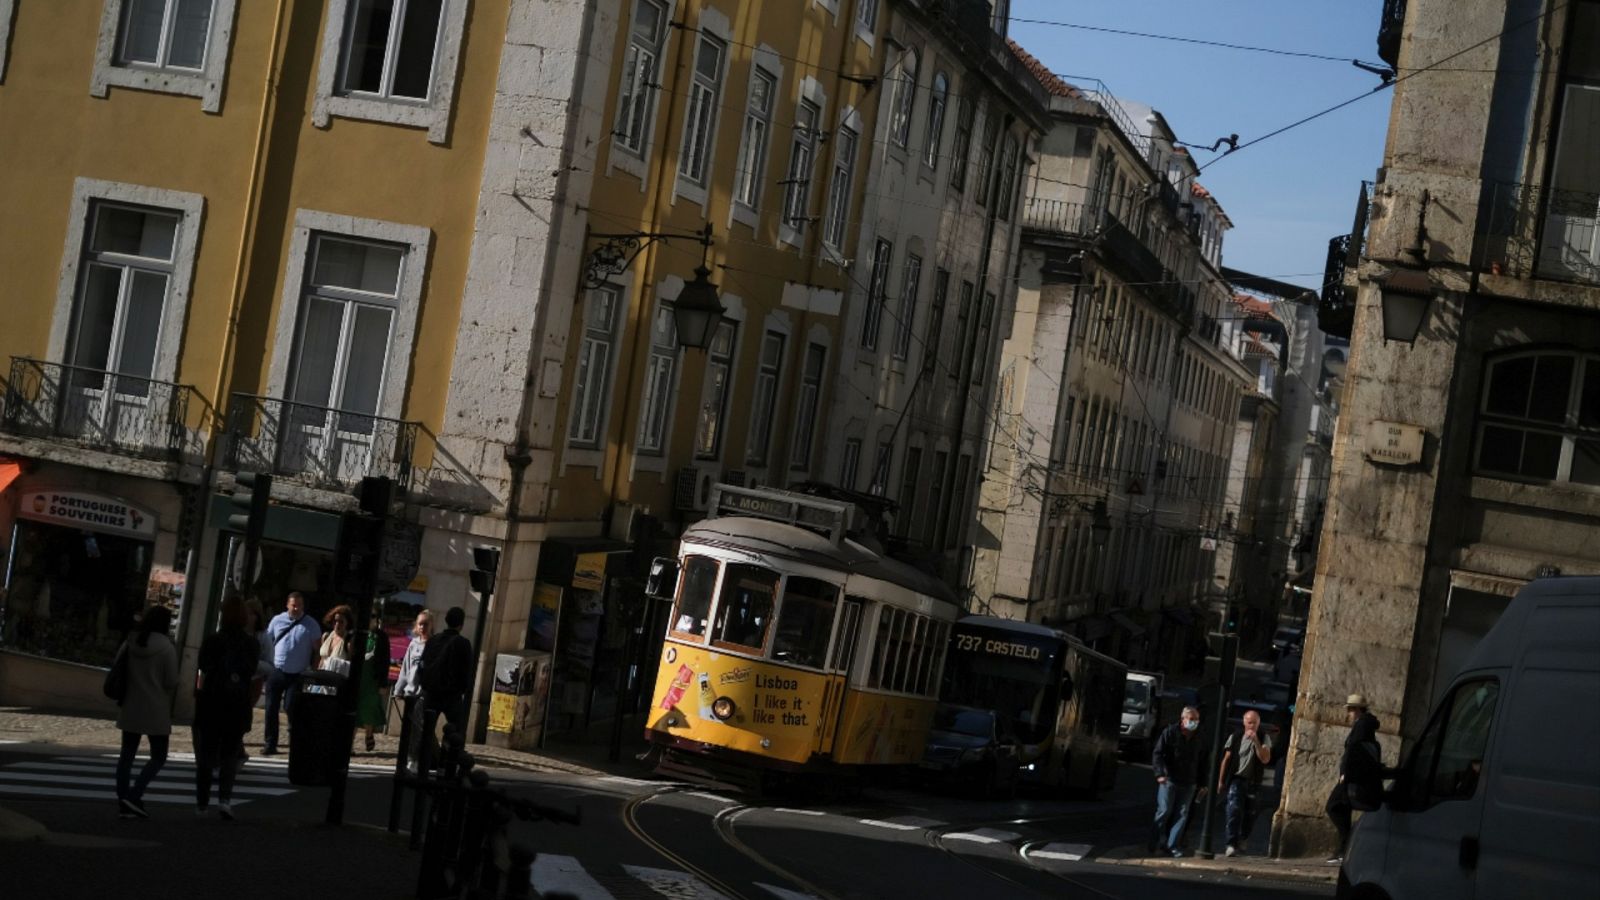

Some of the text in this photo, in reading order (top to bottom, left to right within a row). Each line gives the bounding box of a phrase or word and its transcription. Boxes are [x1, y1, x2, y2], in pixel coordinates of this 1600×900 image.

[52, 494, 126, 516] PORTUGUESE
[740, 497, 775, 513] MONI
[50, 505, 125, 527] SOUVENIRS
[956, 633, 1040, 660] 737 CASTELO
[755, 674, 798, 691] Lisboa
[754, 693, 803, 711] I like it
[753, 710, 809, 726] like that.
